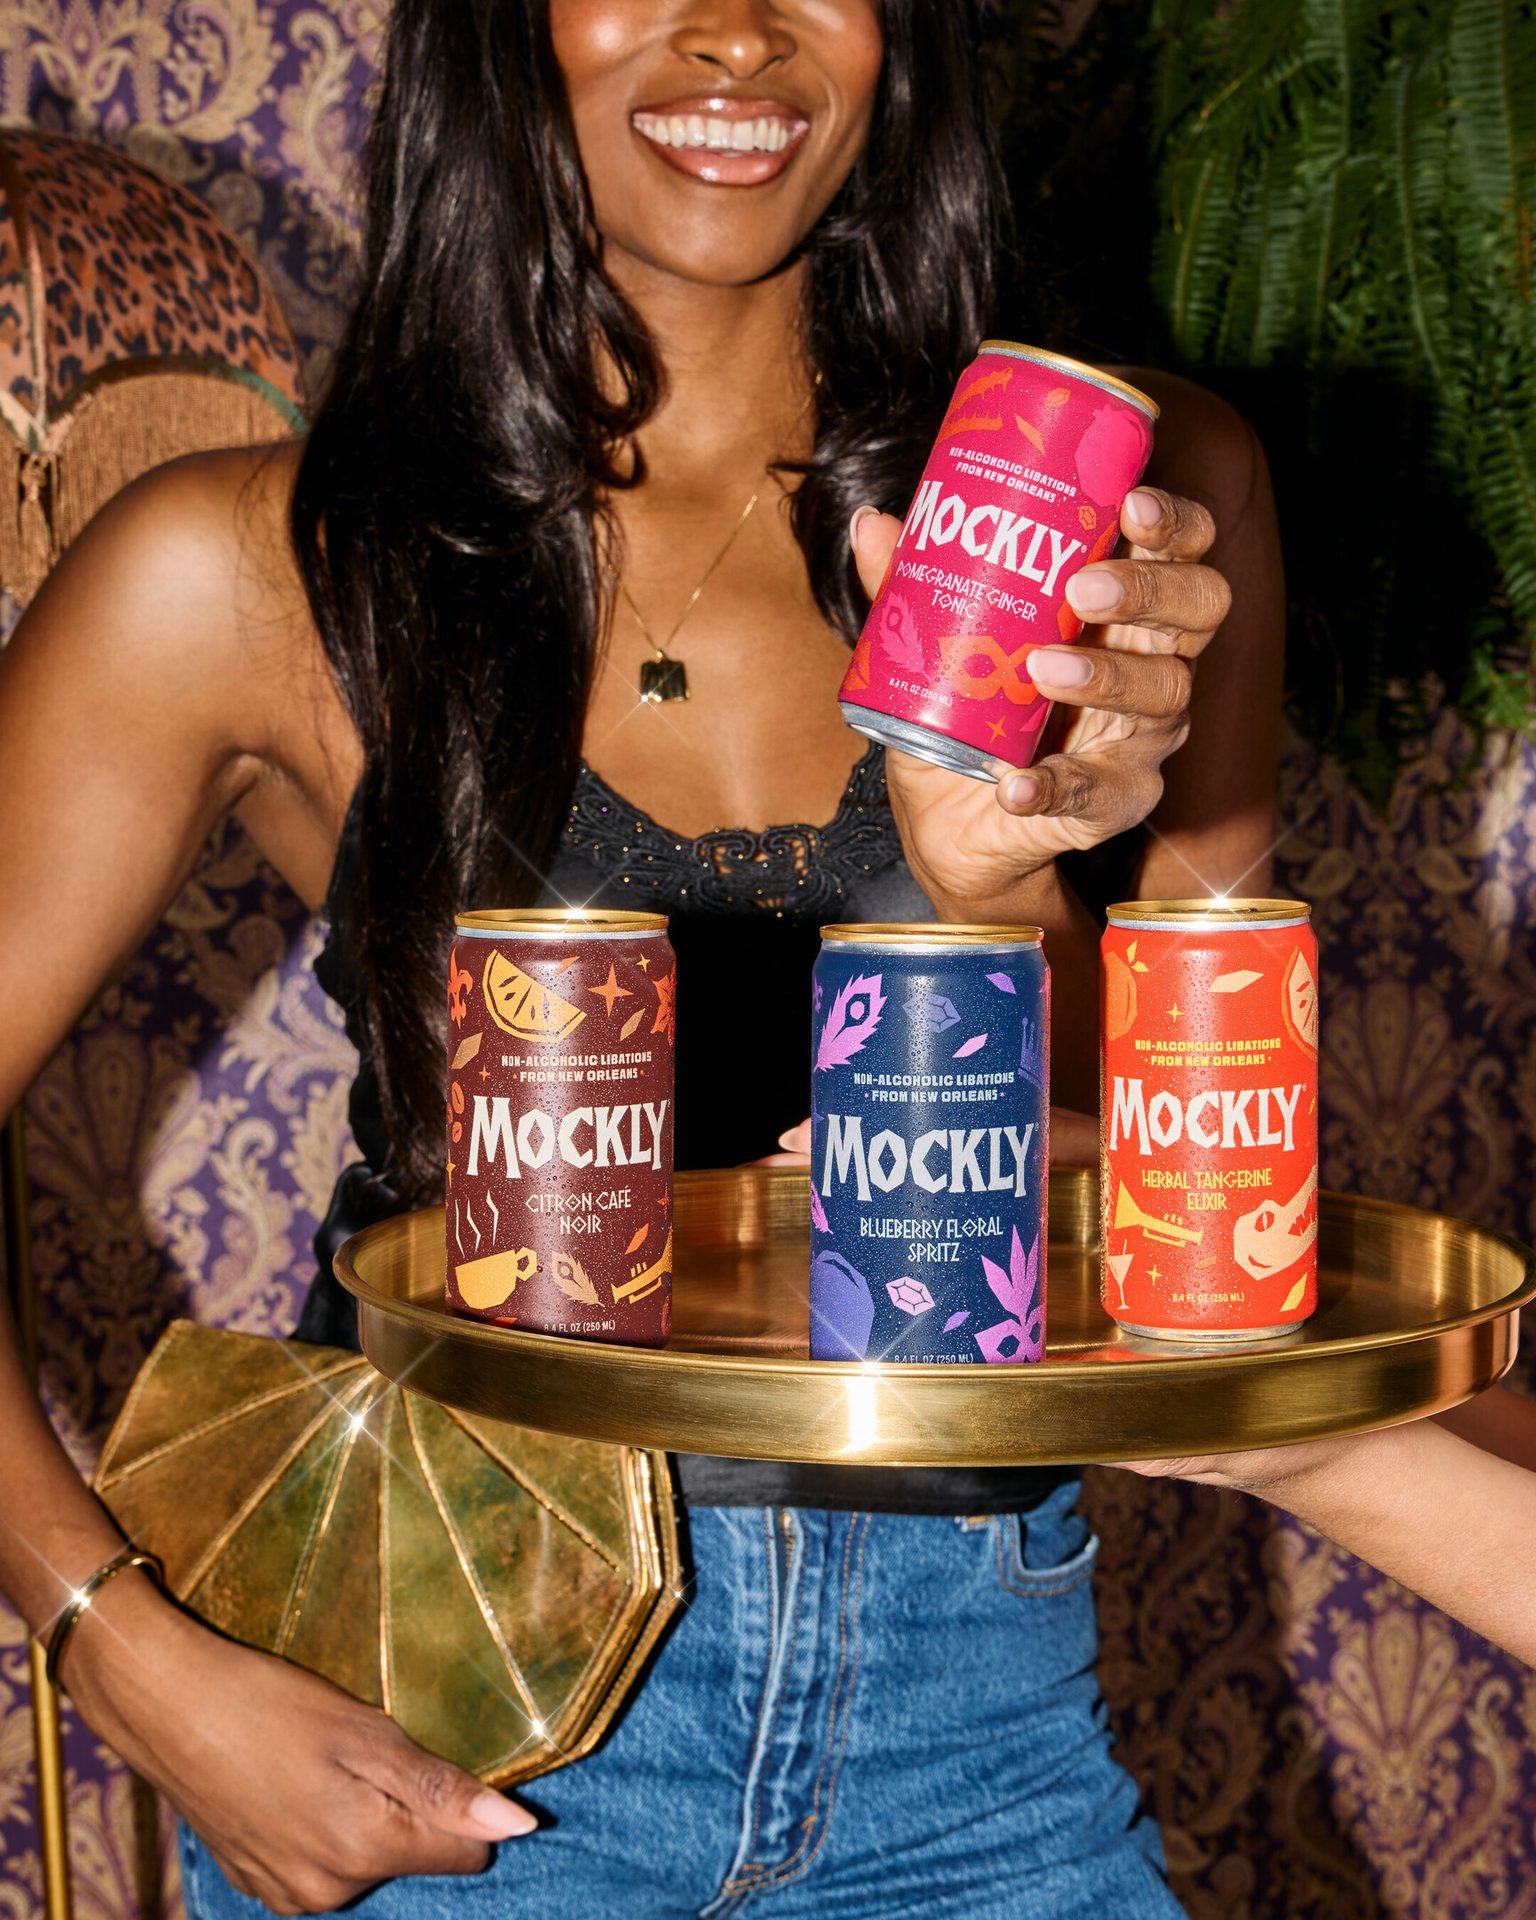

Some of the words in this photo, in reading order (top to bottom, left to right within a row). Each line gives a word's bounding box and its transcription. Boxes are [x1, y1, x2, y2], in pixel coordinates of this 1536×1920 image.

[949, 447, 1023, 475] NON-ALCOHOLIC
[1024, 467, 1077, 497] LIBATIONS
[955, 462, 986, 477] FROM
[983, 469, 1007, 484] NEW
[1006, 477, 1057, 503] ORLEANS
[897, 480, 1082, 597] MOCKLY
[895, 560, 987, 600] POMEGRANATE
[986, 589, 1038, 622] GINGER
[931, 589, 979, 619] TONIC
[889, 678, 901, 688] 8.4
[900, 681, 909, 691] FL
[910, 684, 921, 695] OZ
[920, 688, 938, 701] (250
[939, 694, 953, 708] ML)
[1135, 1039, 1224, 1052] NON-ALCOHOLIC
[1226, 1038, 1281, 1051] LIBATIONS
[501, 1054, 599, 1067] NON-ALCOHOLIC
[600, 1051, 652, 1065] LIBATIONS
[1151, 1055, 1183, 1067] FROM
[1185, 1055, 1209, 1067] NEW
[1213, 1054, 1266, 1067] ORLEANS
[520, 1071, 555, 1082] FROM
[558, 1070, 584, 1082] NEW
[586, 1068, 638, 1081] ORLEANS
[854, 1073, 954, 1086] NON-ALCOHOLIC
[956, 1072, 1015, 1086] LIBATIONS
[872, 1090, 908, 1102] FROM
[911, 1091, 940, 1103] NEW
[941, 1089, 998, 1102] ORLEANS
[1109, 1075, 1302, 1156] MOCKLY
[466, 1095, 667, 1179] MOCKLY
[821, 1113, 1035, 1202] MOCKLY
[1142, 1169, 1191, 1189] HERBAL
[1194, 1168, 1272, 1189] TANGERINE
[525, 1193, 593, 1214] CITRON
[595, 1185, 631, 1211] CAFÉ
[1187, 1192, 1228, 1211] ELIXIR
[560, 1216, 602, 1235] NOIR
[860, 1217, 942, 1238] BLUEBERRY
[946, 1216, 1003, 1238] FLORAL
[907, 1242, 960, 1263] SPRITZ
[1172, 1292, 1184, 1302] 8.4
[1186, 1293, 1195, 1302] FL
[1198, 1293, 1208, 1302] OZ
[1210, 1292, 1229, 1303] (250
[1230, 1291, 1245, 1302] ML)
[544, 1323, 556, 1332] 84
[559, 1323, 568, 1332] FL
[570, 1322, 580, 1332] OZ
[582, 1321, 600, 1333] (250
[602, 1320, 616, 1331] ML)
[923, 1354, 934, 1364] OZ
[936, 1354, 956, 1364] (250
[958, 1353, 974, 1364] ML)
